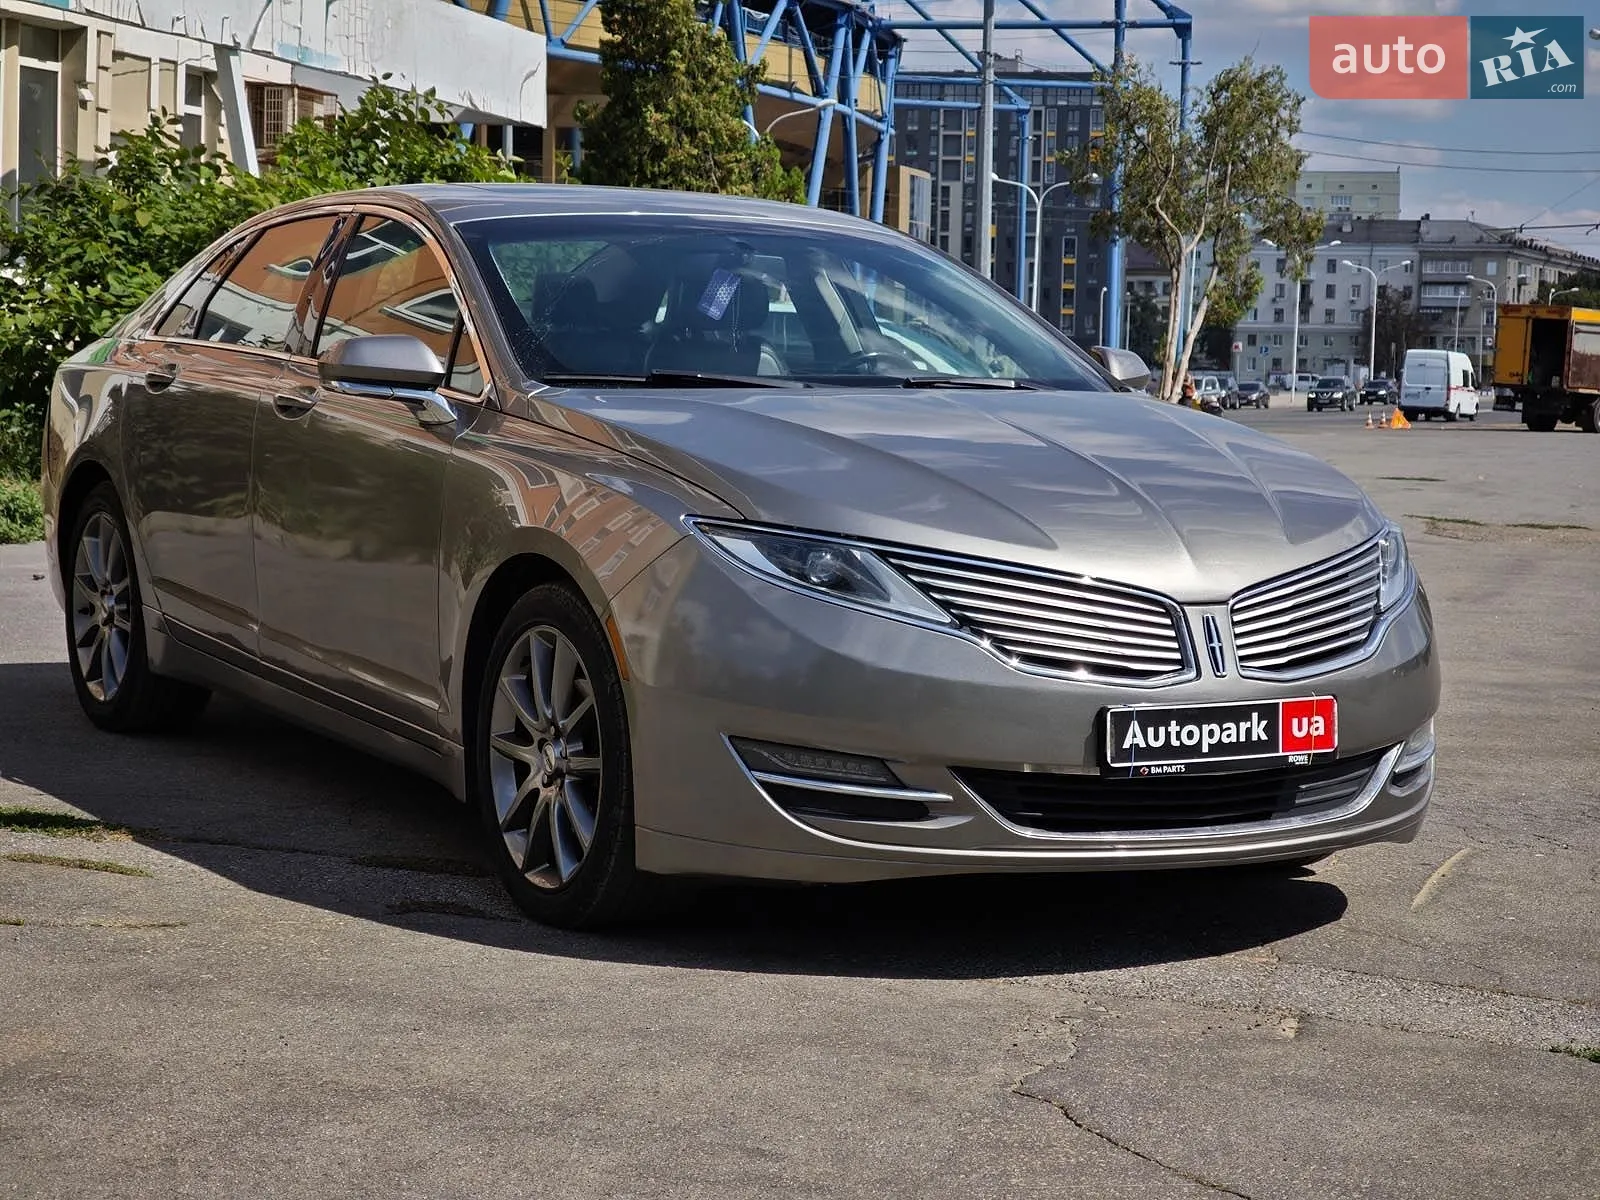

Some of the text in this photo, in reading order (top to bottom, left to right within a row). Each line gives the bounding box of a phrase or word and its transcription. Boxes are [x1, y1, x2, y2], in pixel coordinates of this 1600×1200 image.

[1123, 712, 1325, 752] Autopark ua
[1288, 754, 1309, 763] ROWE
[1150, 764, 1186, 774] BM PARTS
